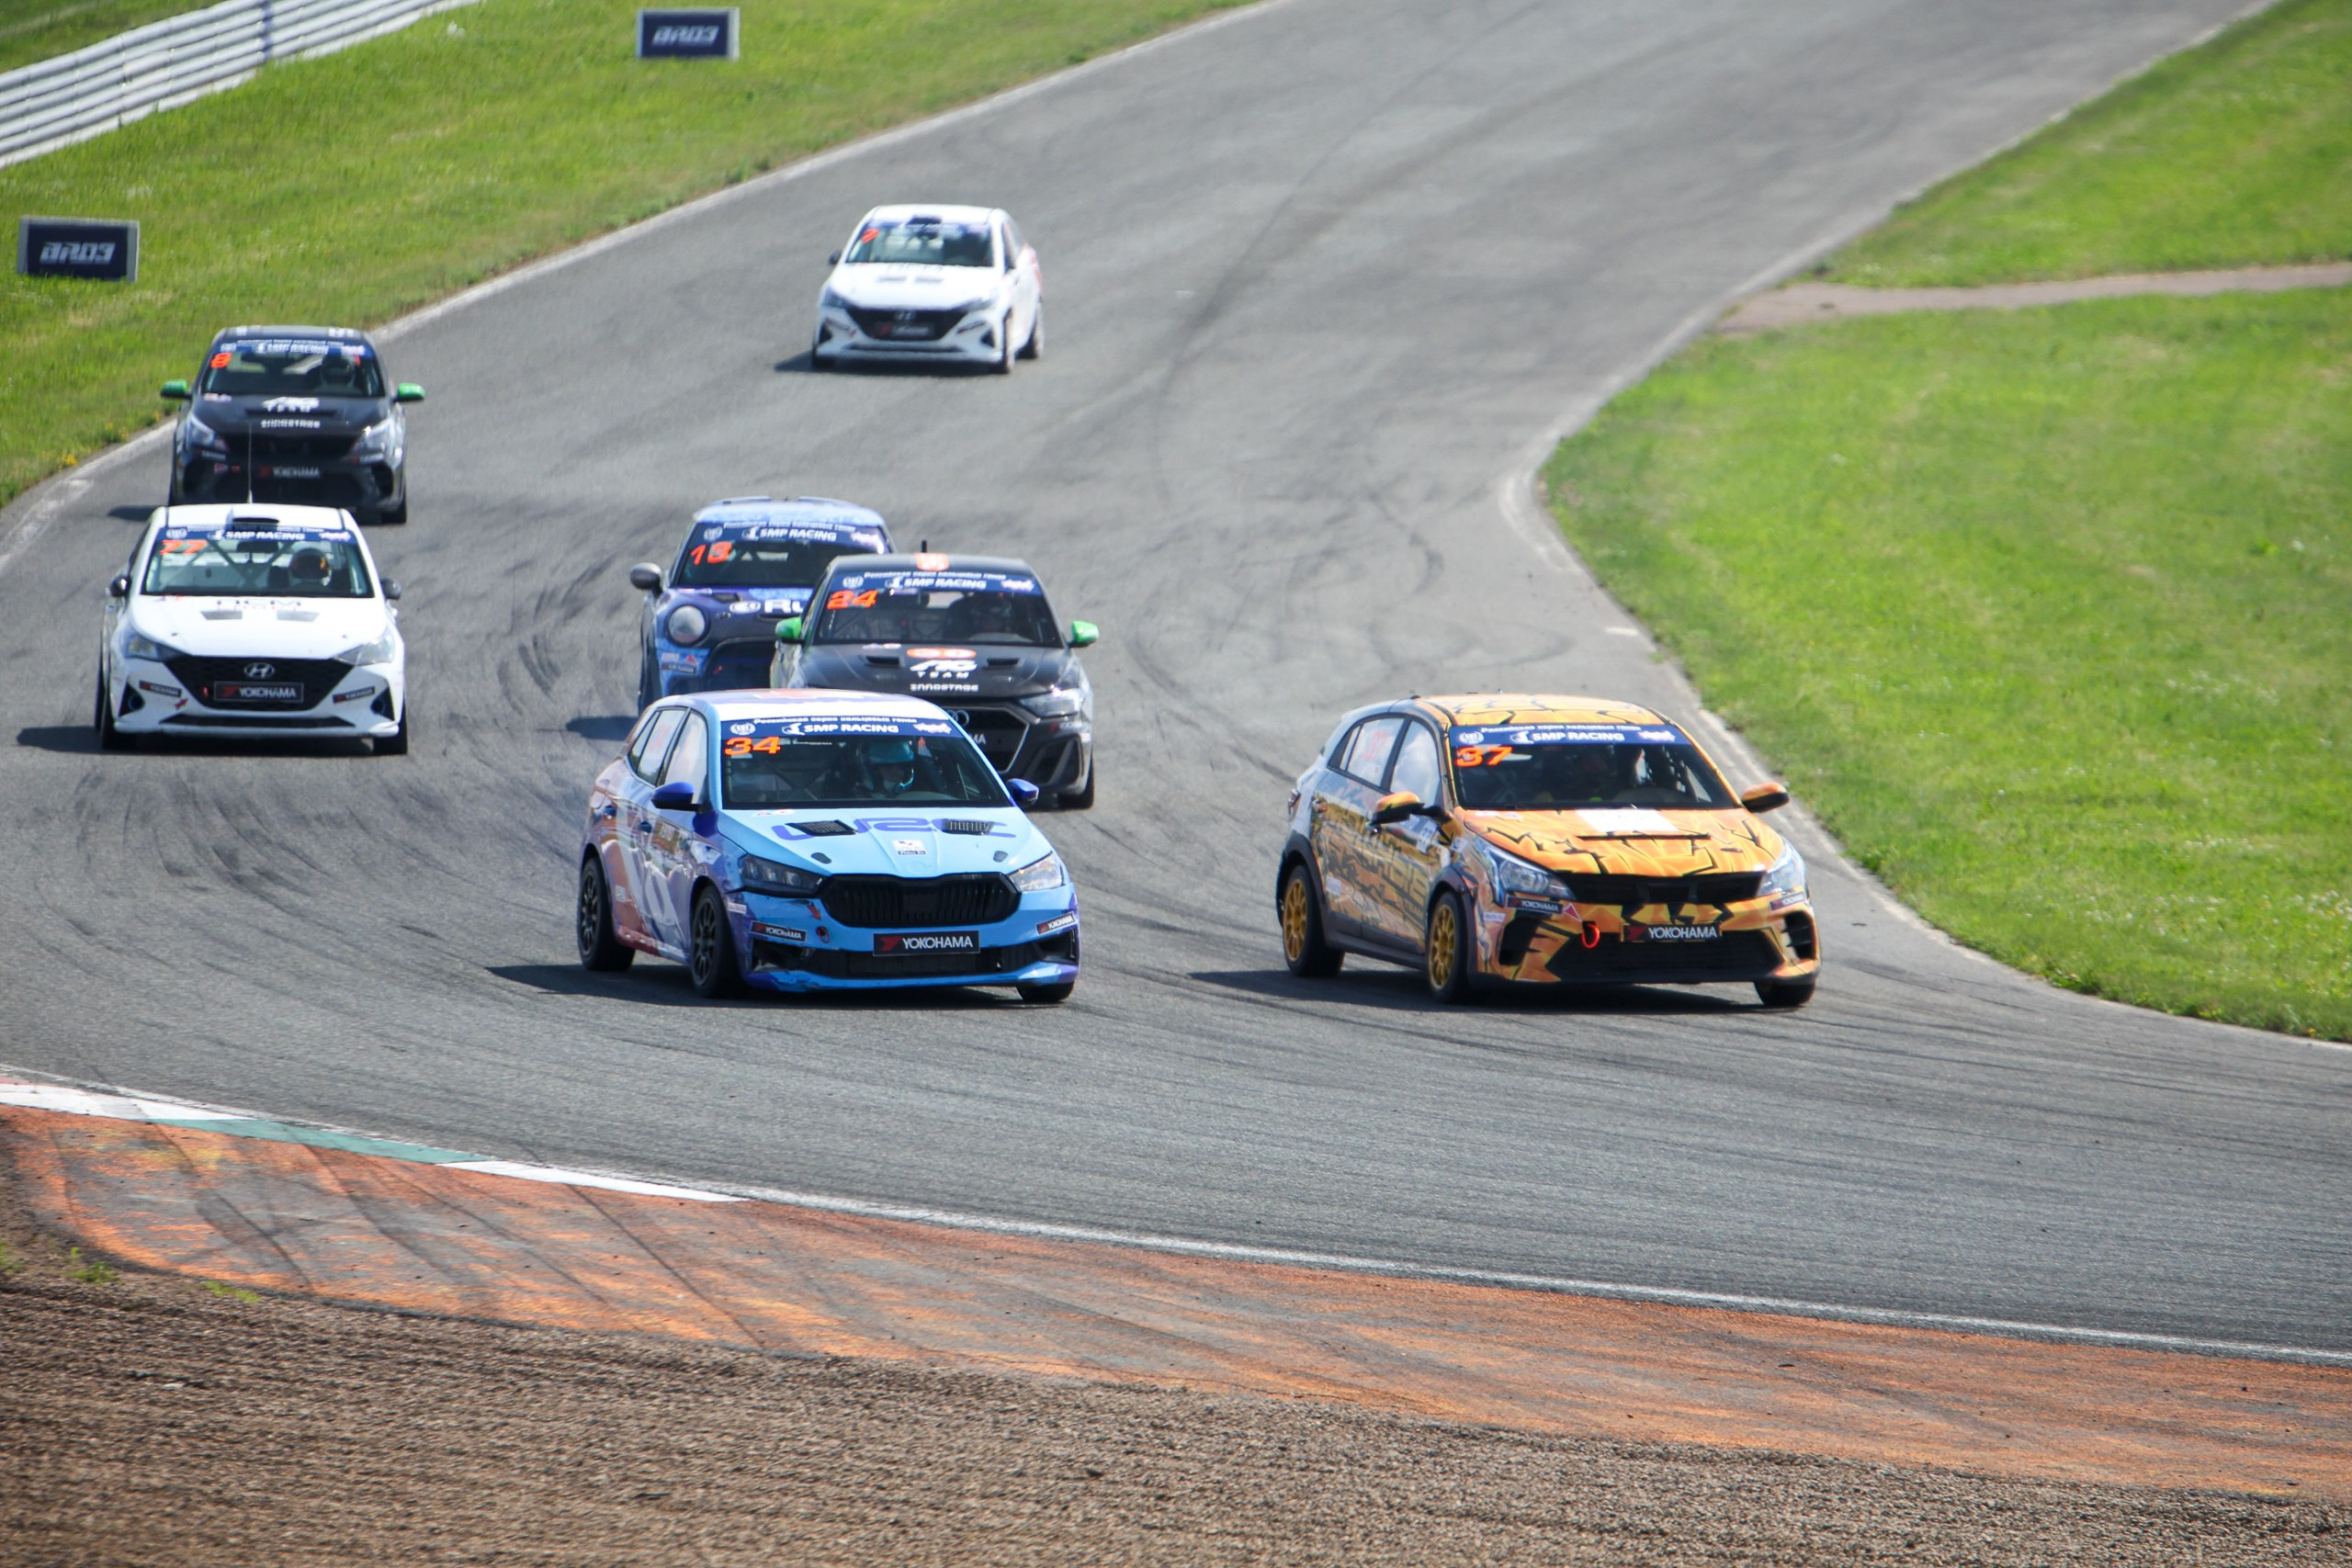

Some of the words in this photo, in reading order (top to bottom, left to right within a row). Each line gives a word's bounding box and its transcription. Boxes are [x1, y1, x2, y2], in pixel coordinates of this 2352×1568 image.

[225, 531, 255, 540] SMP
[256, 531, 305, 541] RACING
[759, 527, 789, 538] SMP
[789, 528, 837, 542] RACING
[903, 578, 934, 588] SMP
[934, 579, 987, 591] RACING
[827, 589, 878, 610] 24
[239, 686, 297, 698] YOKOHAMA
[804, 724, 839, 733] SMP
[840, 724, 899, 733] RACING
[1532, 731, 1566, 741] SMP
[1567, 732, 1625, 742] RACING
[724, 736, 781, 756] 34
[1454, 745, 1514, 768] 37
[1521, 899, 1560, 912] YOKOHAMA
[765, 926, 802, 940] YOKOHAMA
[1647, 926, 1719, 939] YOKOHAMA
[902, 935, 974, 950] YOKOHAMA
